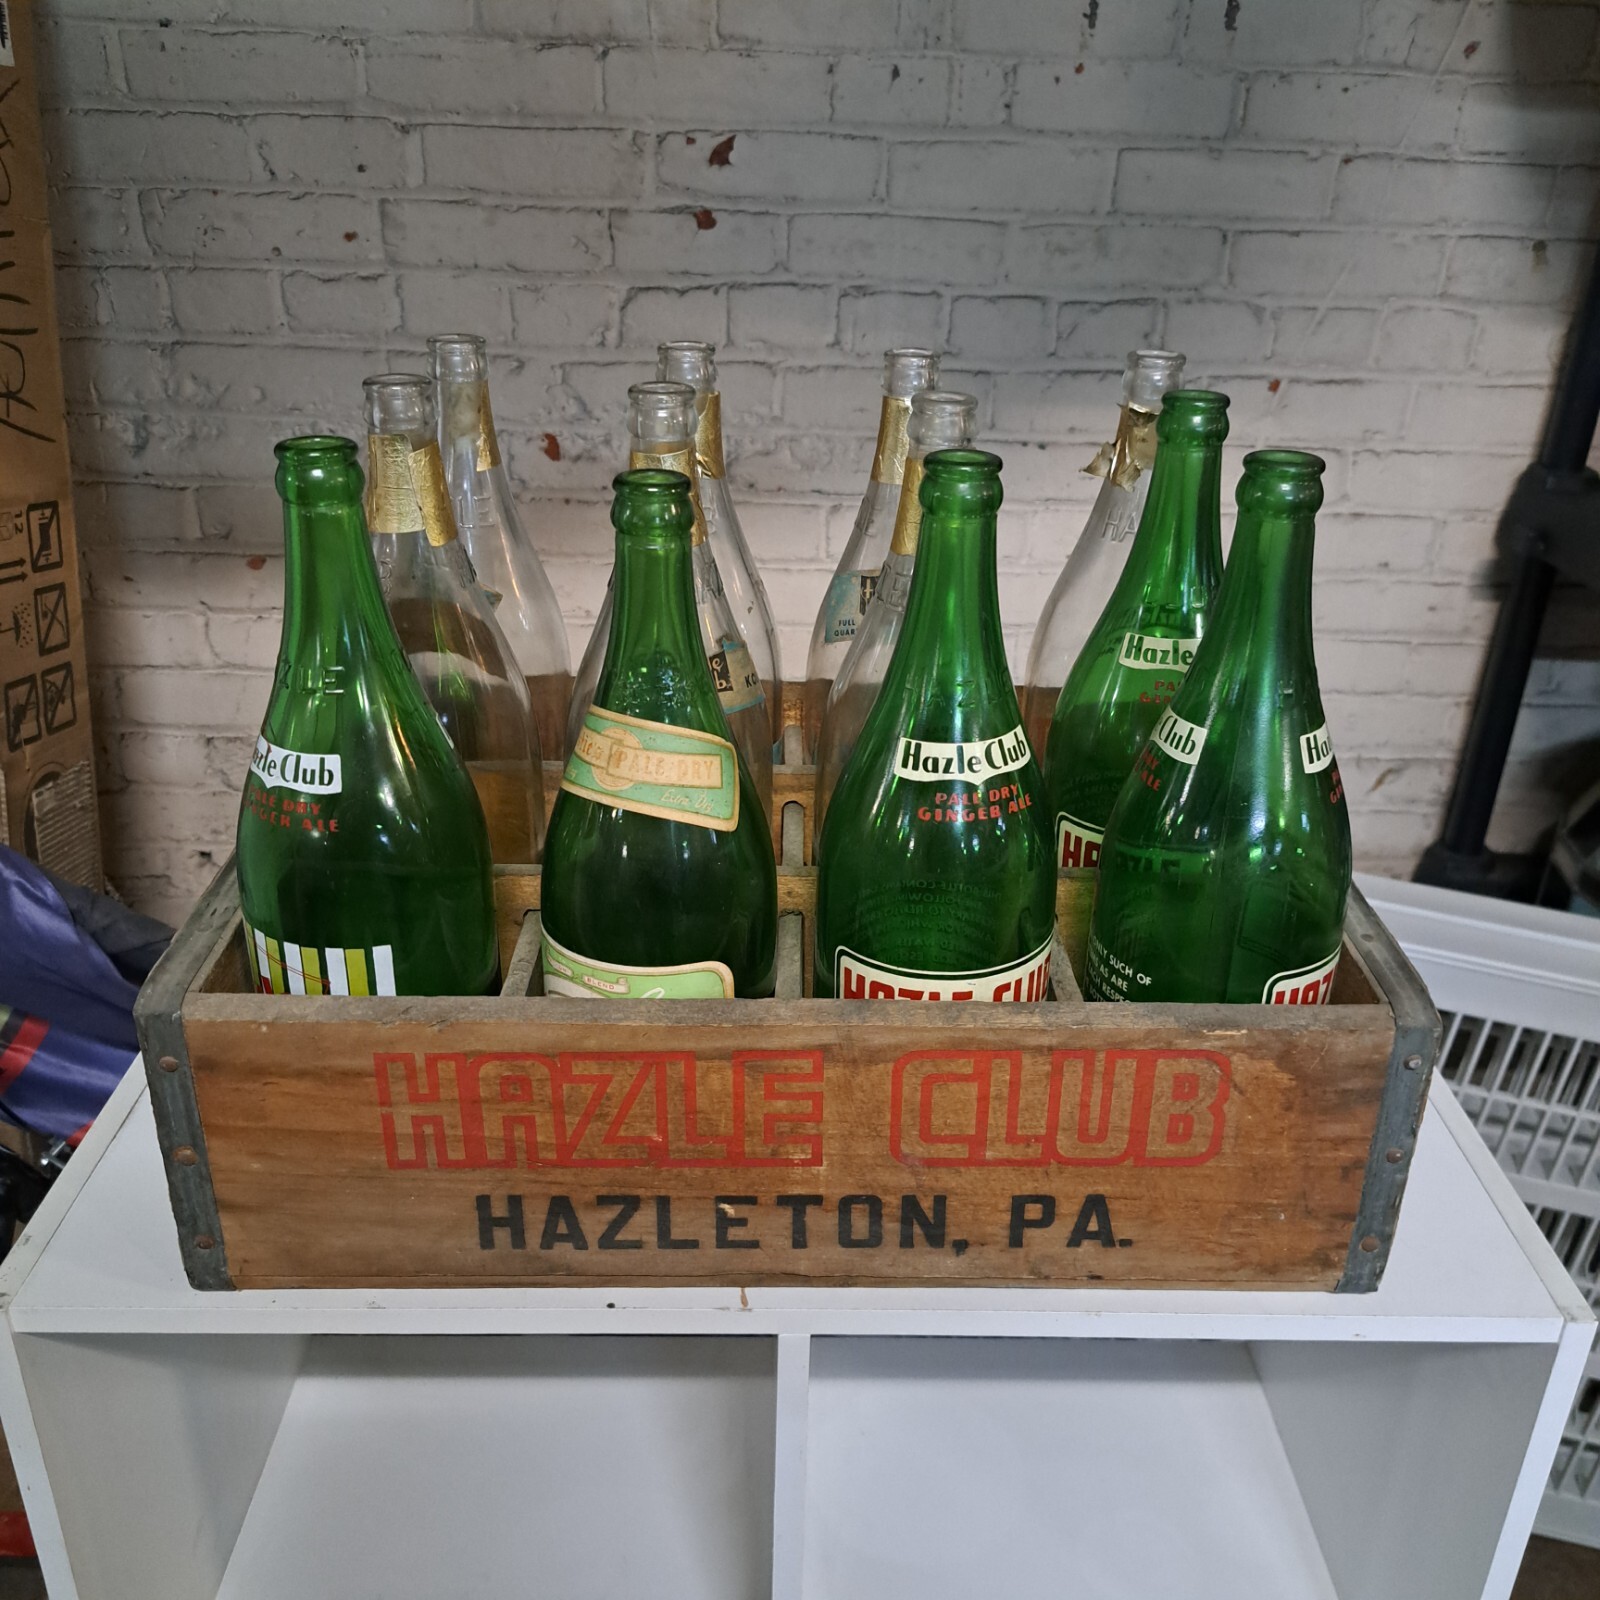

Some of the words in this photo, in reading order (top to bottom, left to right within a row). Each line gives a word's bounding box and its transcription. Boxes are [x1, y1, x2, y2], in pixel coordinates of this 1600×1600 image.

[833, 628, 858, 637] QUAR
[1124, 634, 1194, 665] Hazle
[1159, 715, 1196, 756] Club
[901, 740, 982, 774] Hazle
[984, 731, 1027, 770] Club
[280, 754, 334, 787] Club
[282, 799, 321, 816] DRY
[917, 803, 1001, 823] GINGER
[1008, 793, 1032, 814] ALE
[935, 792, 982, 806] PALE
[989, 783, 1018, 802] DRY
[301, 819, 339, 833] ALE
[1100, 963, 1109, 978] AS
[1110, 974, 1128, 992] ARE
[1109, 954, 1133, 978] SUCH
[1136, 972, 1152, 987] OF
[373, 1050, 824, 1170] HAZLE
[889, 1049, 1232, 1168] CLUB
[475, 1194, 969, 1257] HAZLETON,
[1008, 1194, 1133, 1249] PA.
